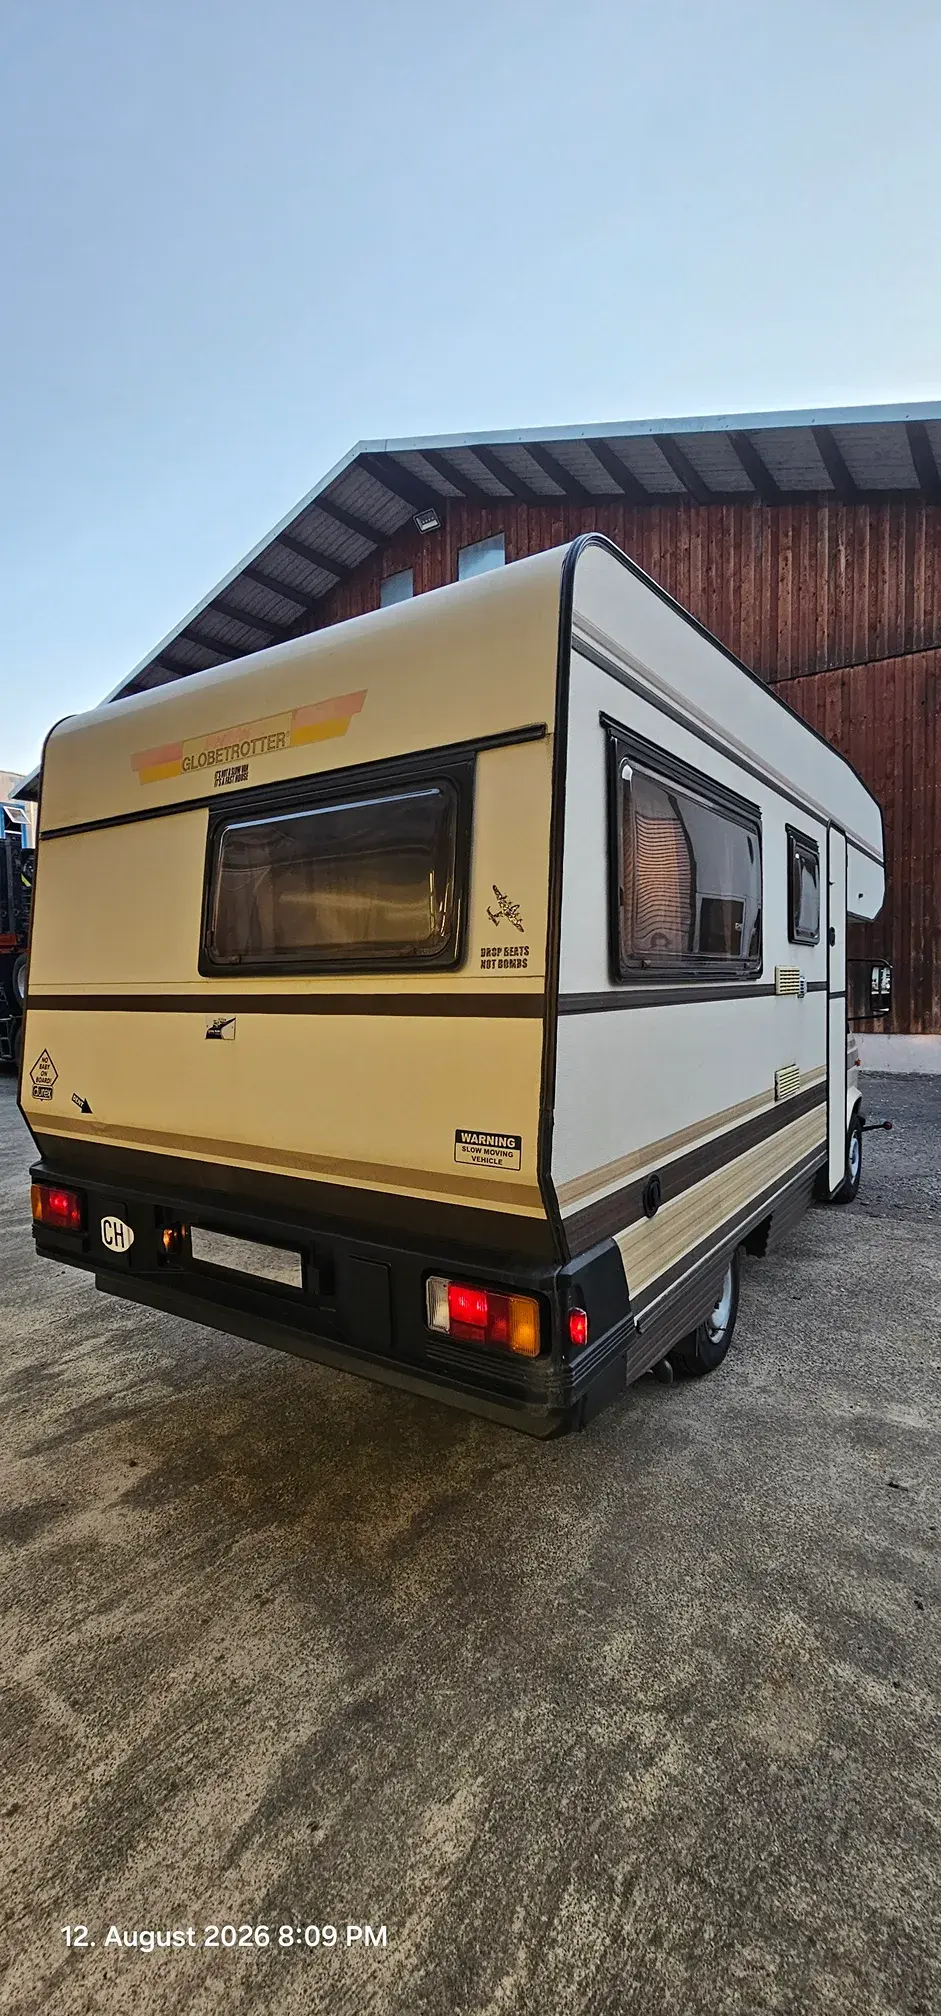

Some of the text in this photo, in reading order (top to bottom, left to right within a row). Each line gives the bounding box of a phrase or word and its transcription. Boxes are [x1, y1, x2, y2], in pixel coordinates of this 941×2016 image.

[182, 731, 286, 772] GLOBETROTTER
[481, 946, 530, 957] DROP BEATS
[481, 958, 528, 969] NOT BOMBS
[33, 1086, 51, 1097] durex
[72, 1095, 84, 1107] DENT
[461, 1132, 516, 1148] WARNING
[461, 1146, 514, 1158] SLOW MOVING
[471, 1155, 503, 1165] VEHICLE
[103, 1219, 125, 1249] CH
